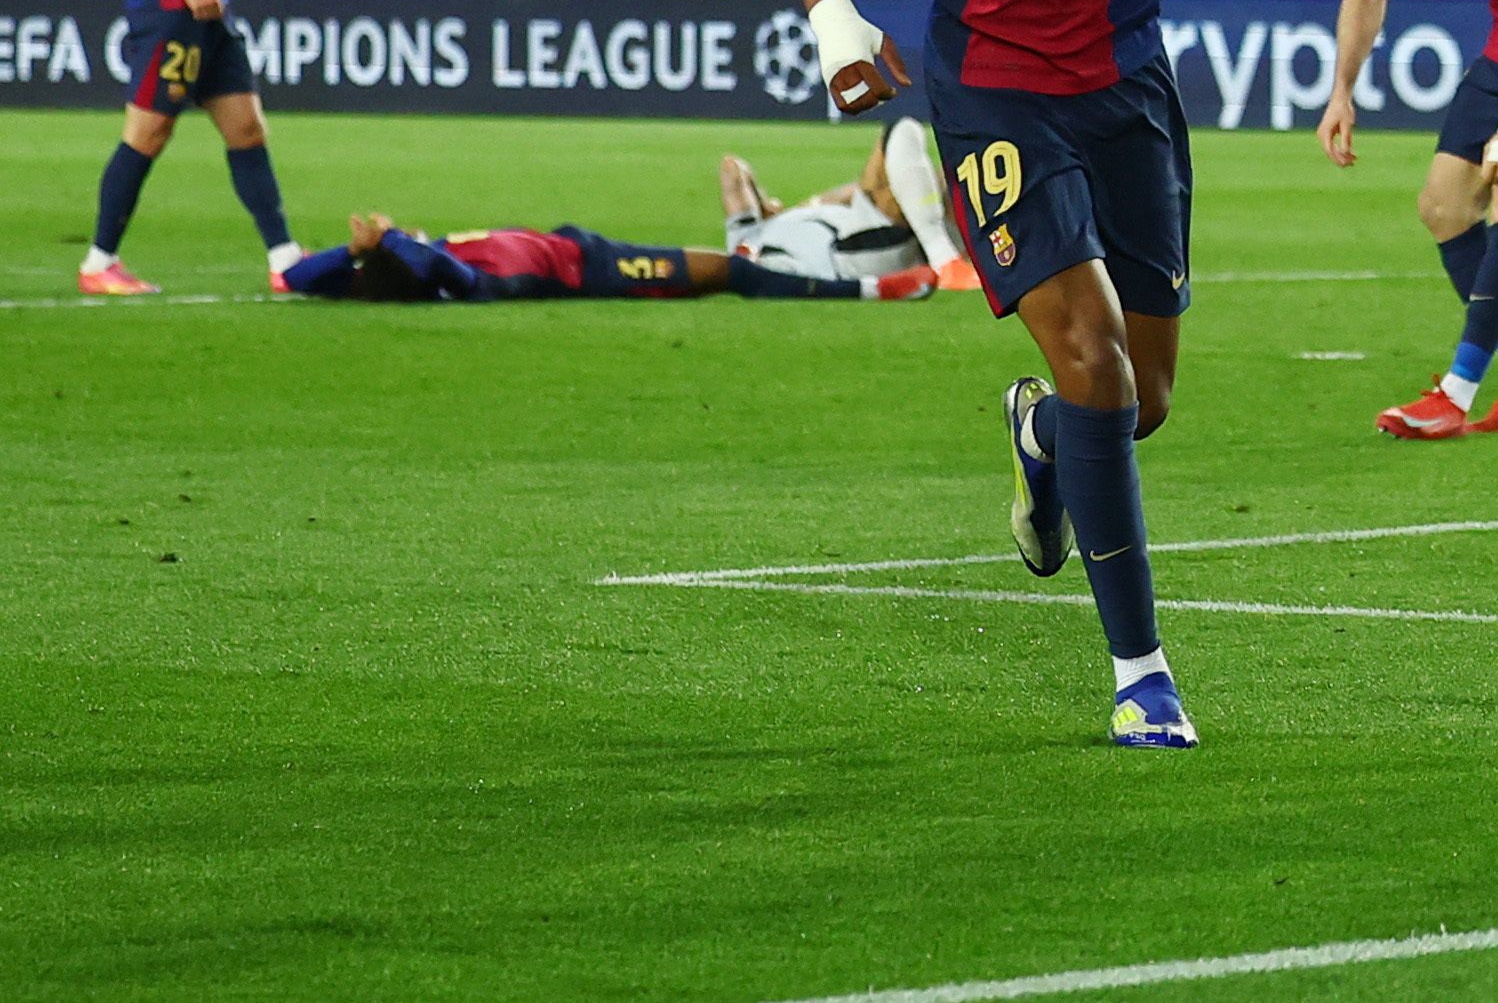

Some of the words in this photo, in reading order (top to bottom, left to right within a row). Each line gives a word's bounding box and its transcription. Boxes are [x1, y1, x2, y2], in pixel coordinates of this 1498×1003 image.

[104, 15, 469, 88] CMPIONS
[491, 17, 738, 91] LEAGUE
[160, 40, 201, 83] 20
[956, 140, 1022, 228] 19
